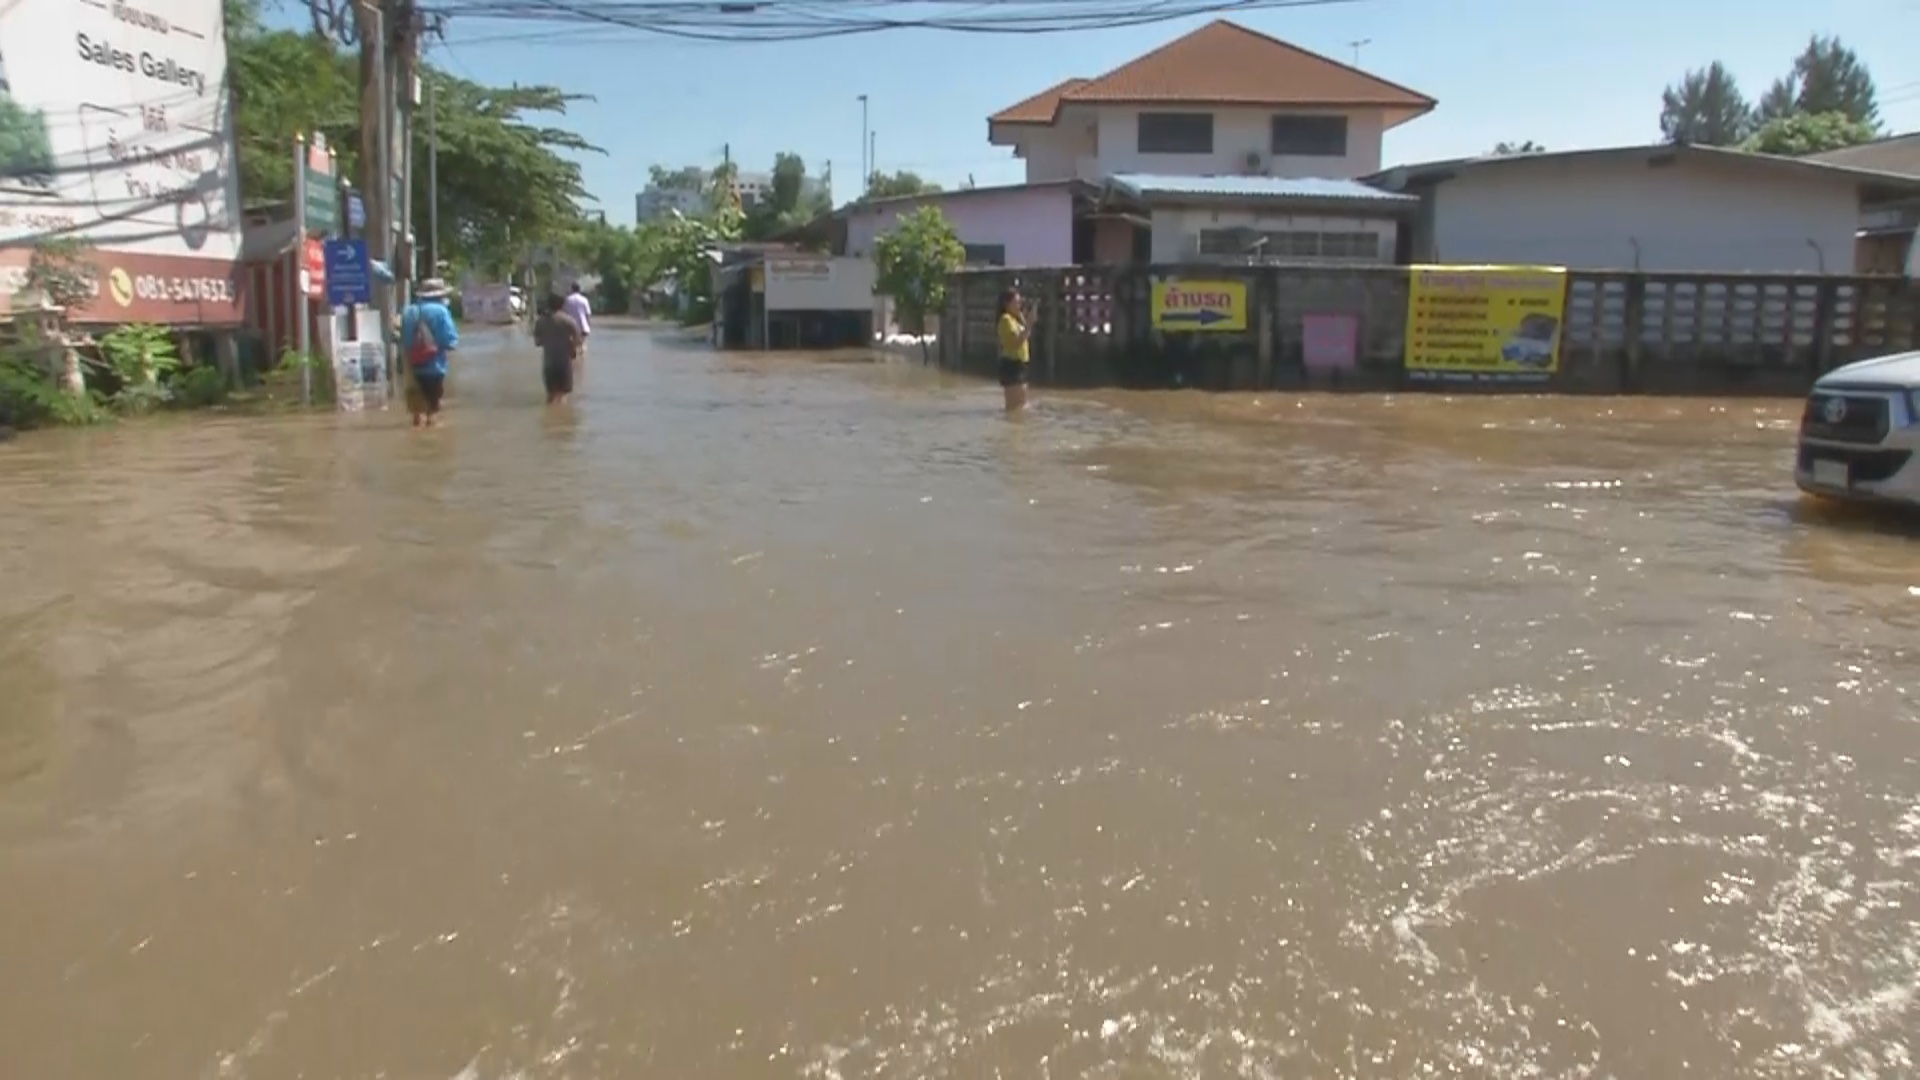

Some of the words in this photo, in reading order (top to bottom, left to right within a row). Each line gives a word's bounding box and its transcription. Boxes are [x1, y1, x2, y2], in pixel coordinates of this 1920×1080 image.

[77, 30, 135, 73] Sales
[139, 51, 206, 97] Gallery
[1164, 286, 1232, 309] ล้างรถ
